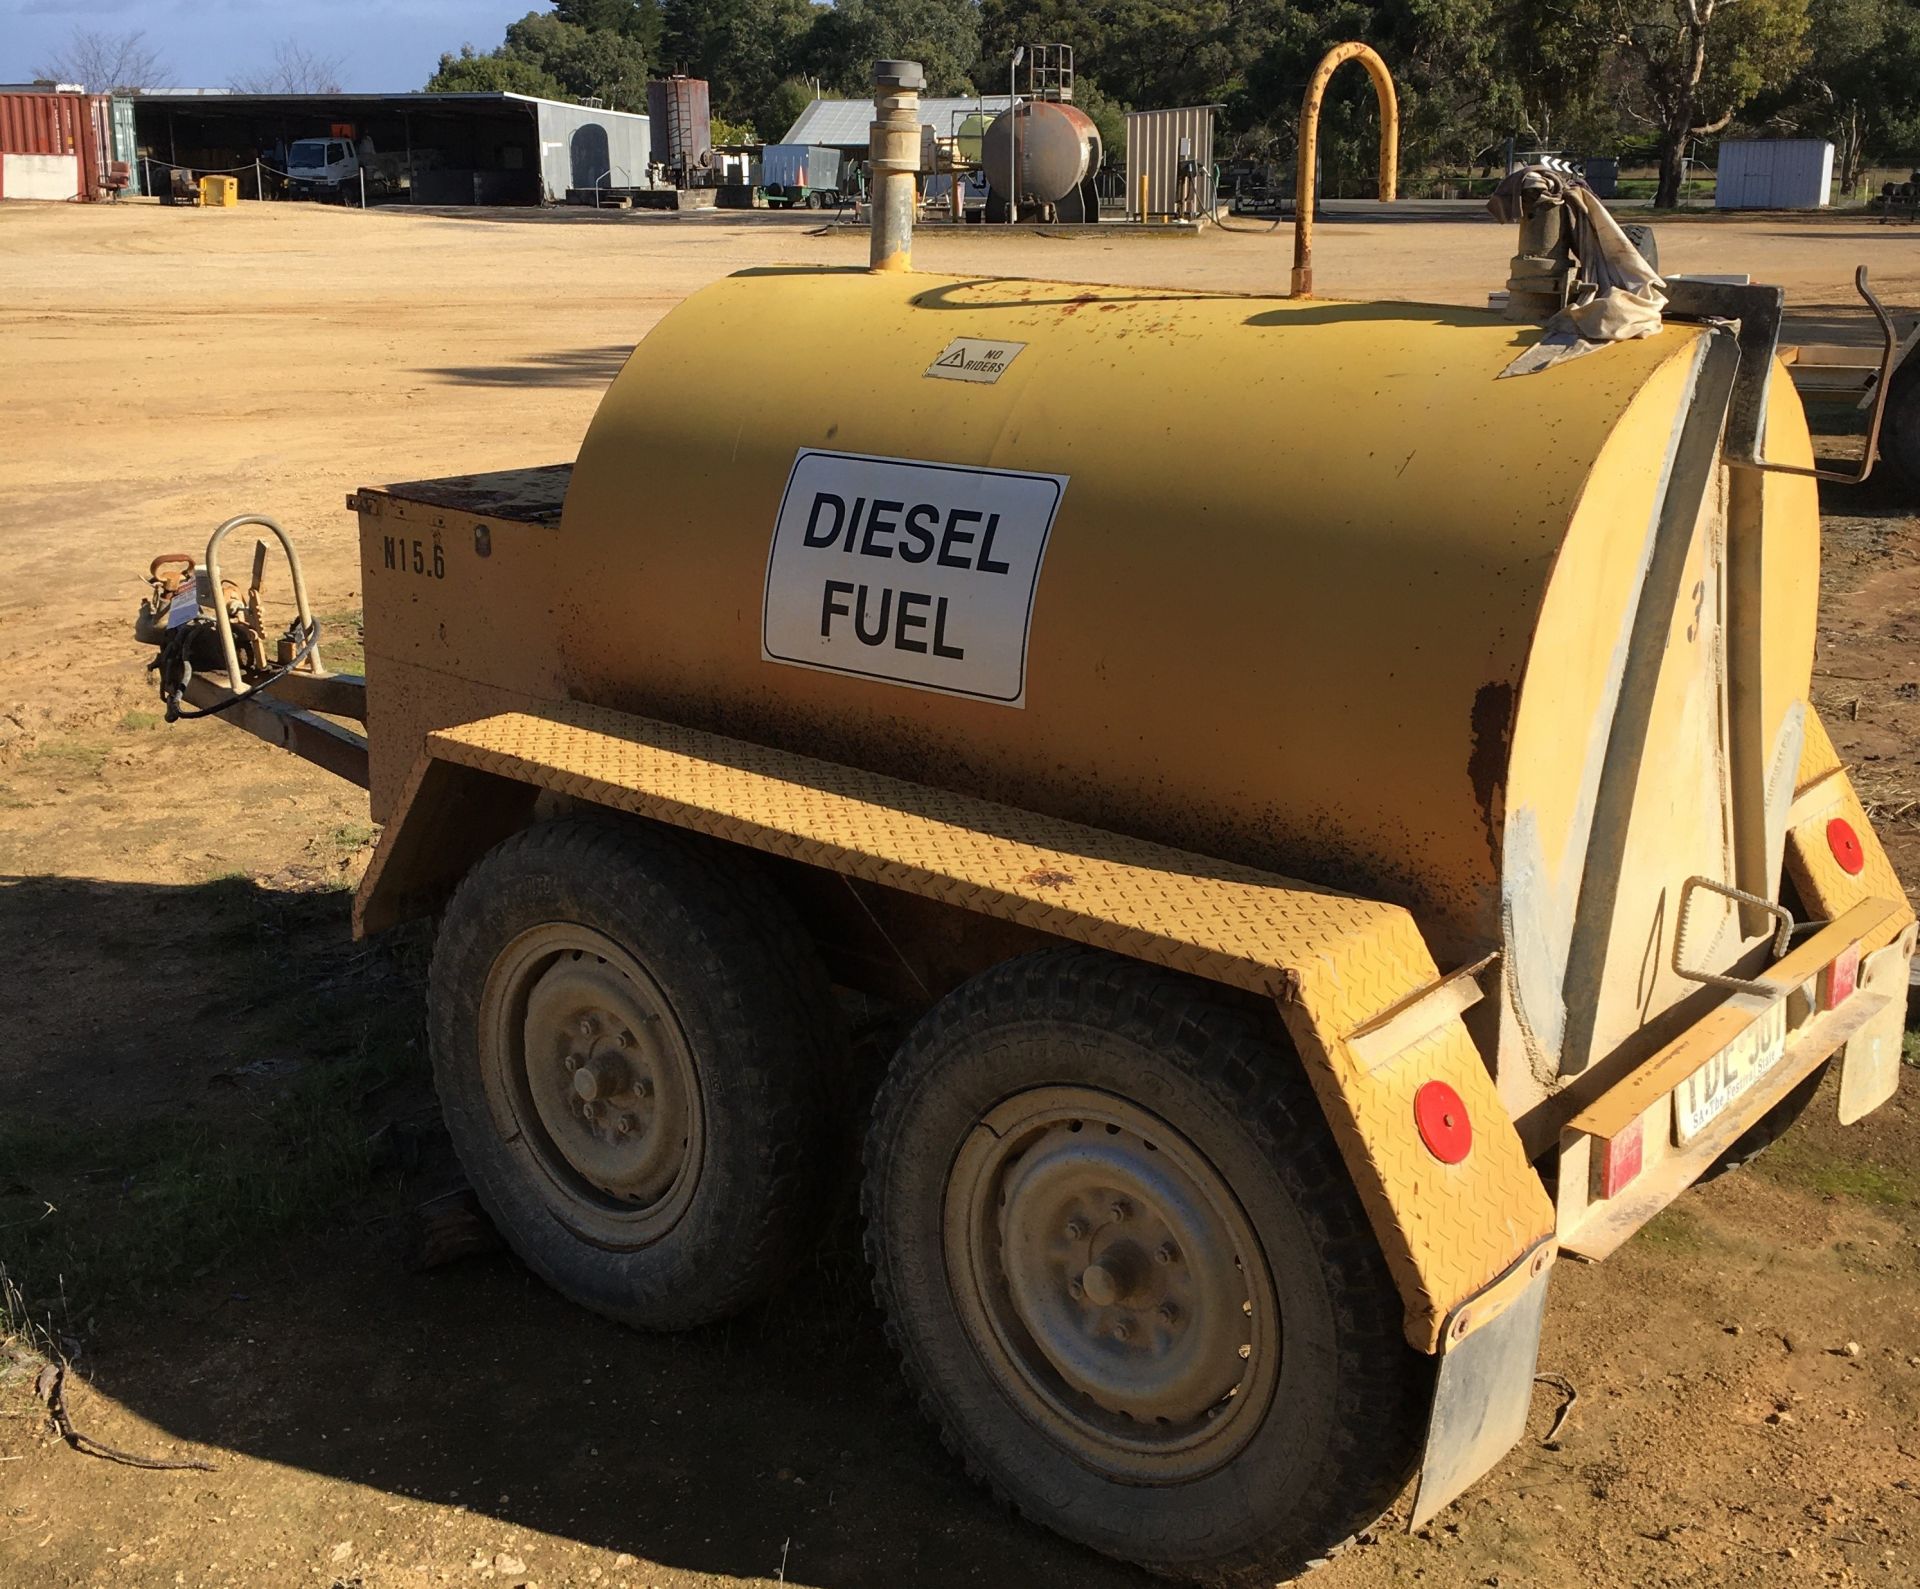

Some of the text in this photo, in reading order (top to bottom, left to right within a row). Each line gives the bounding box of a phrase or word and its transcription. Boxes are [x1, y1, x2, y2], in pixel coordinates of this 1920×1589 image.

[963, 360, 1004, 373] RIDERS
[984, 349, 1004, 360] NO
[803, 492, 1010, 574] DIESEL
[384, 536, 445, 579] N15.6
[821, 579, 964, 660] FUEL
